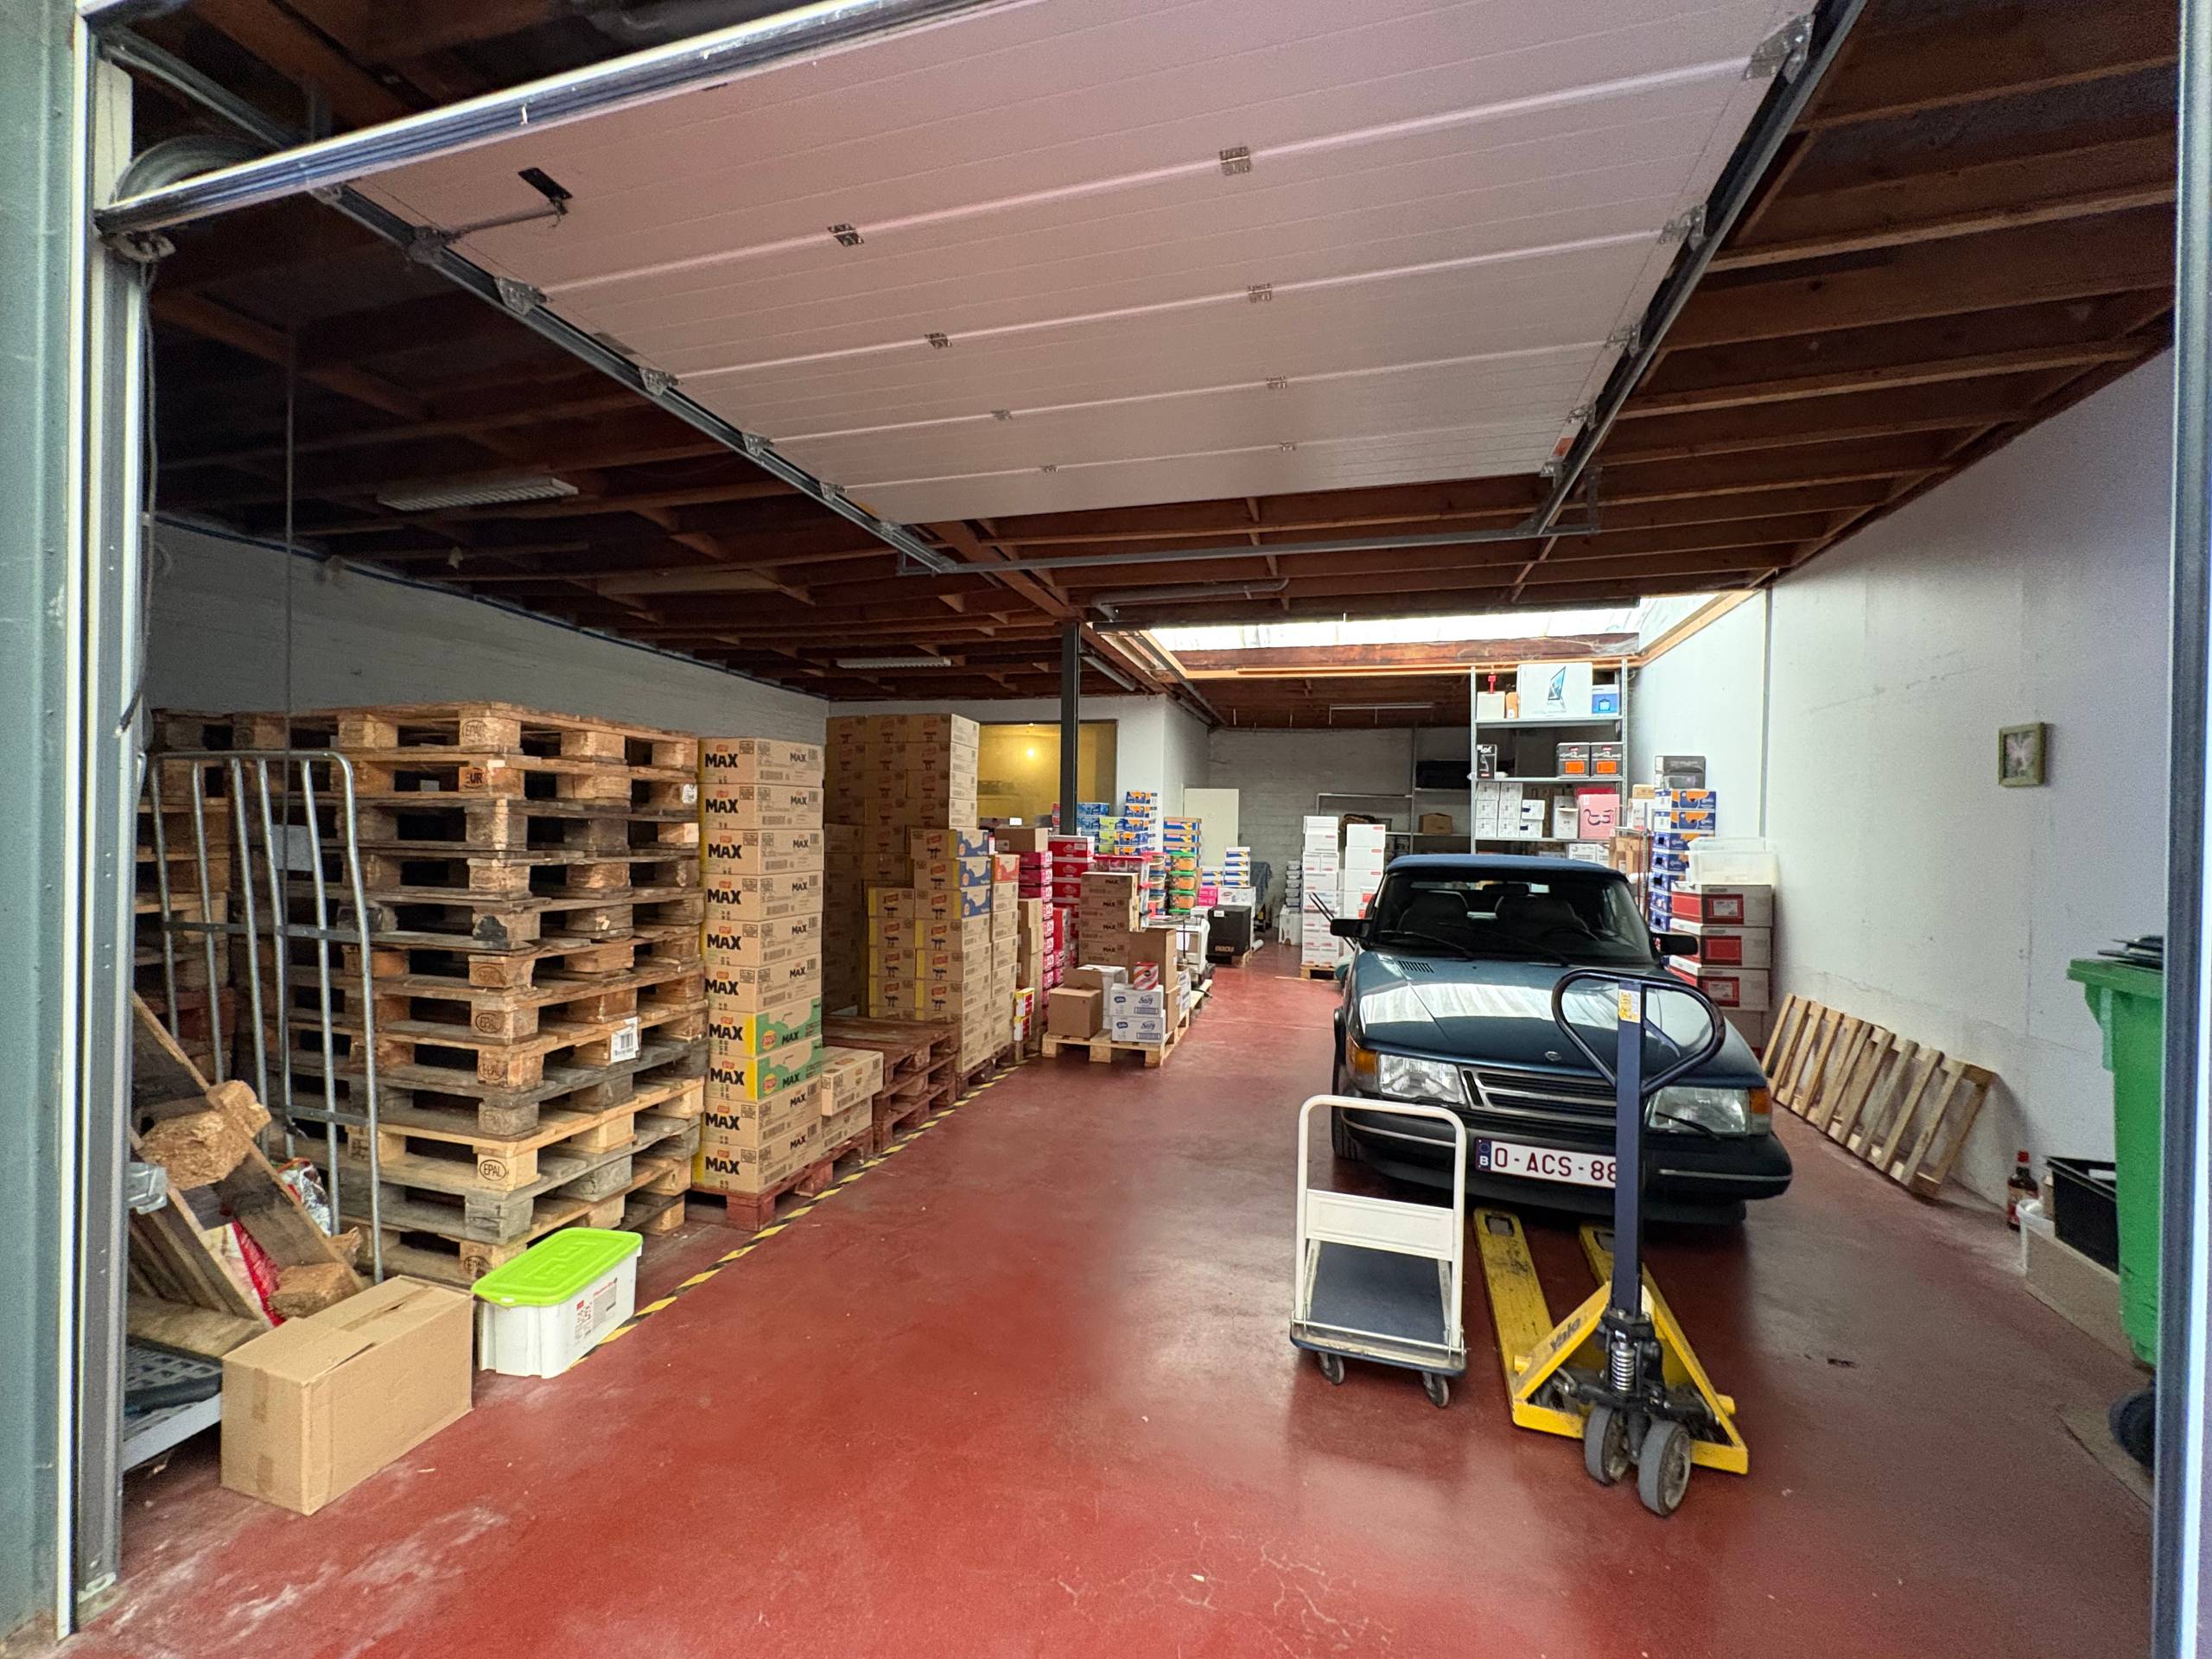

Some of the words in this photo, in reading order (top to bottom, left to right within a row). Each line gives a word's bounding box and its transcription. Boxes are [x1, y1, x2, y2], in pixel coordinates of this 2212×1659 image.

[705, 753, 738, 768] MAX
[790, 753, 807, 762] MAX
[706, 798, 738, 813] MAX
[791, 796, 807, 805] MAX
[709, 843, 742, 859] MAX
[792, 839, 809, 849] MAX
[791, 882, 807, 892] MAX
[708, 889, 741, 905] MAX
[791, 925, 807, 935] MAX
[707, 934, 741, 950] MAX
[790, 967, 806, 978] MAX
[705, 979, 739, 995] MAX
[709, 1024, 743, 1041] MAX
[782, 1031, 799, 1045] MAX
[710, 1068, 744, 1085] MAX
[783, 1073, 799, 1088] MAX
[790, 1094, 806, 1107] MAX
[705, 1114, 740, 1131] MAX
[790, 1135, 806, 1148] MAX
[705, 1156, 740, 1175] MAX
[1479, 1156, 1489, 1166] B
[1495, 1147, 1617, 1182] O-ACS-88
[483, 1164, 502, 1177] EPAL
